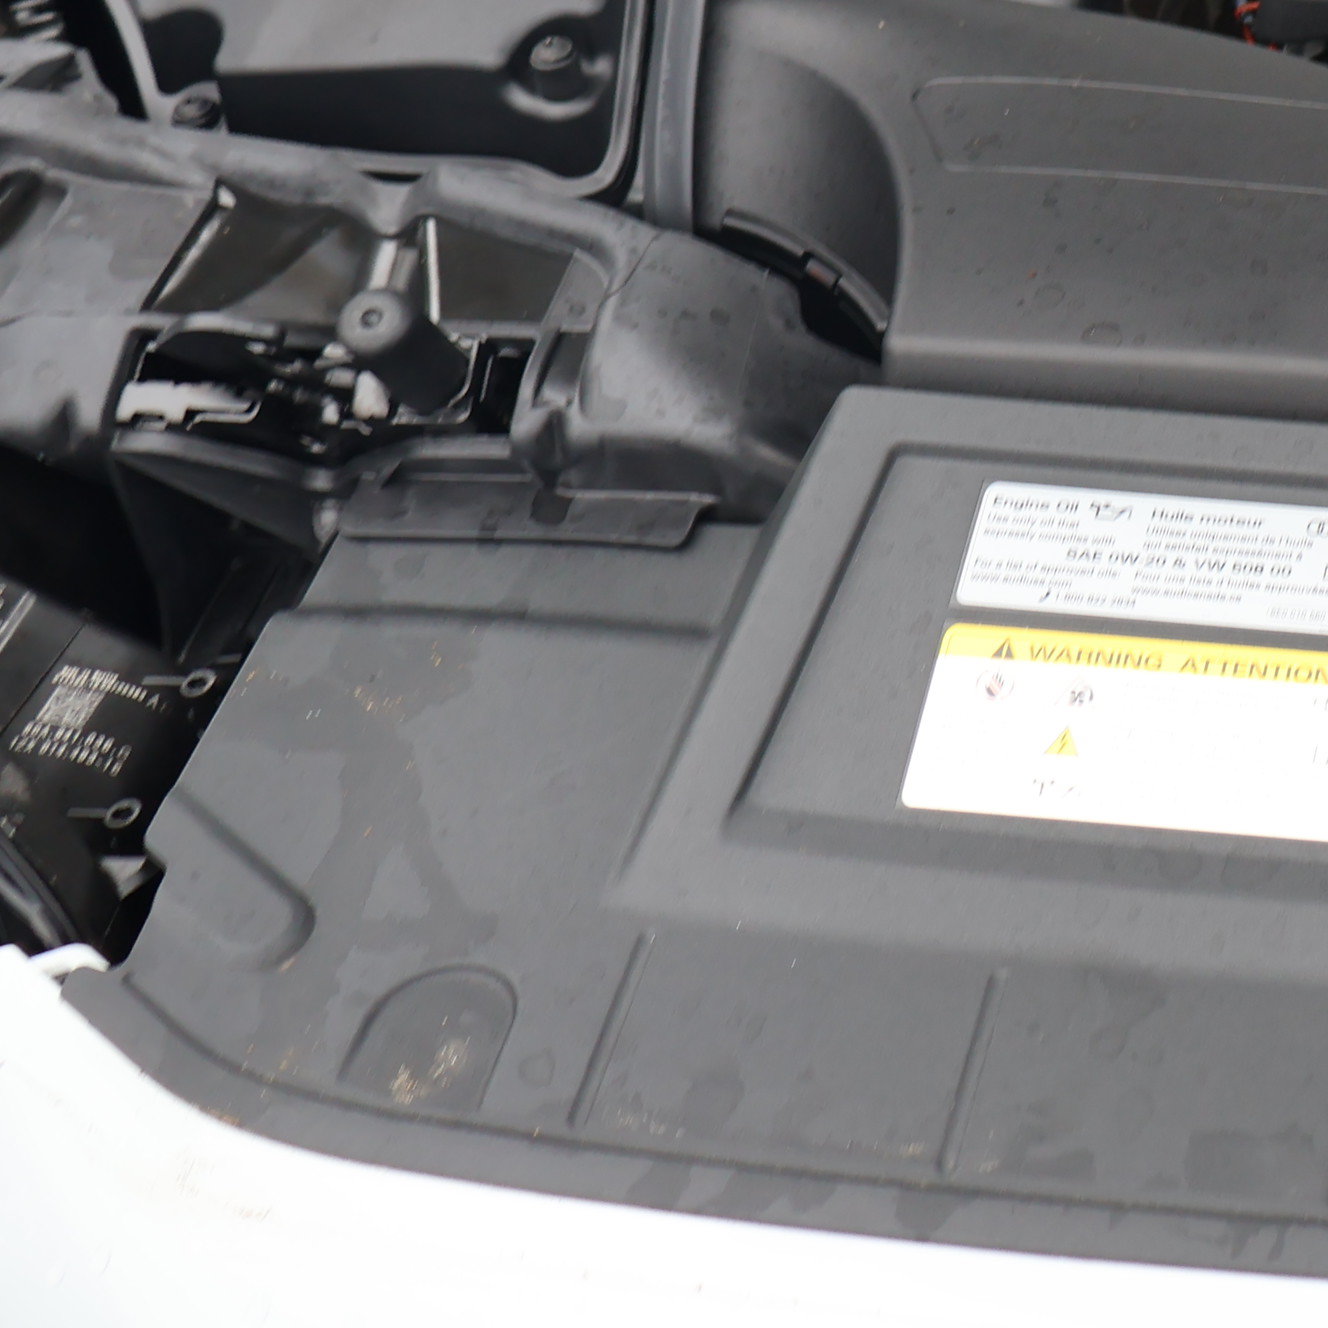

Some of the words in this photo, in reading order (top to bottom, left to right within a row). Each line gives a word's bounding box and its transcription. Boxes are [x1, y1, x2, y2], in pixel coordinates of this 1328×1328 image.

[994, 495, 1050, 510] Engine
[1057, 499, 1080, 513] Oil
[1151, 507, 1194, 523] Huile
[1066, 547, 1102, 562] SAE
[1195, 556, 1227, 571] VW
[1030, 644, 1162, 671] WARNING
